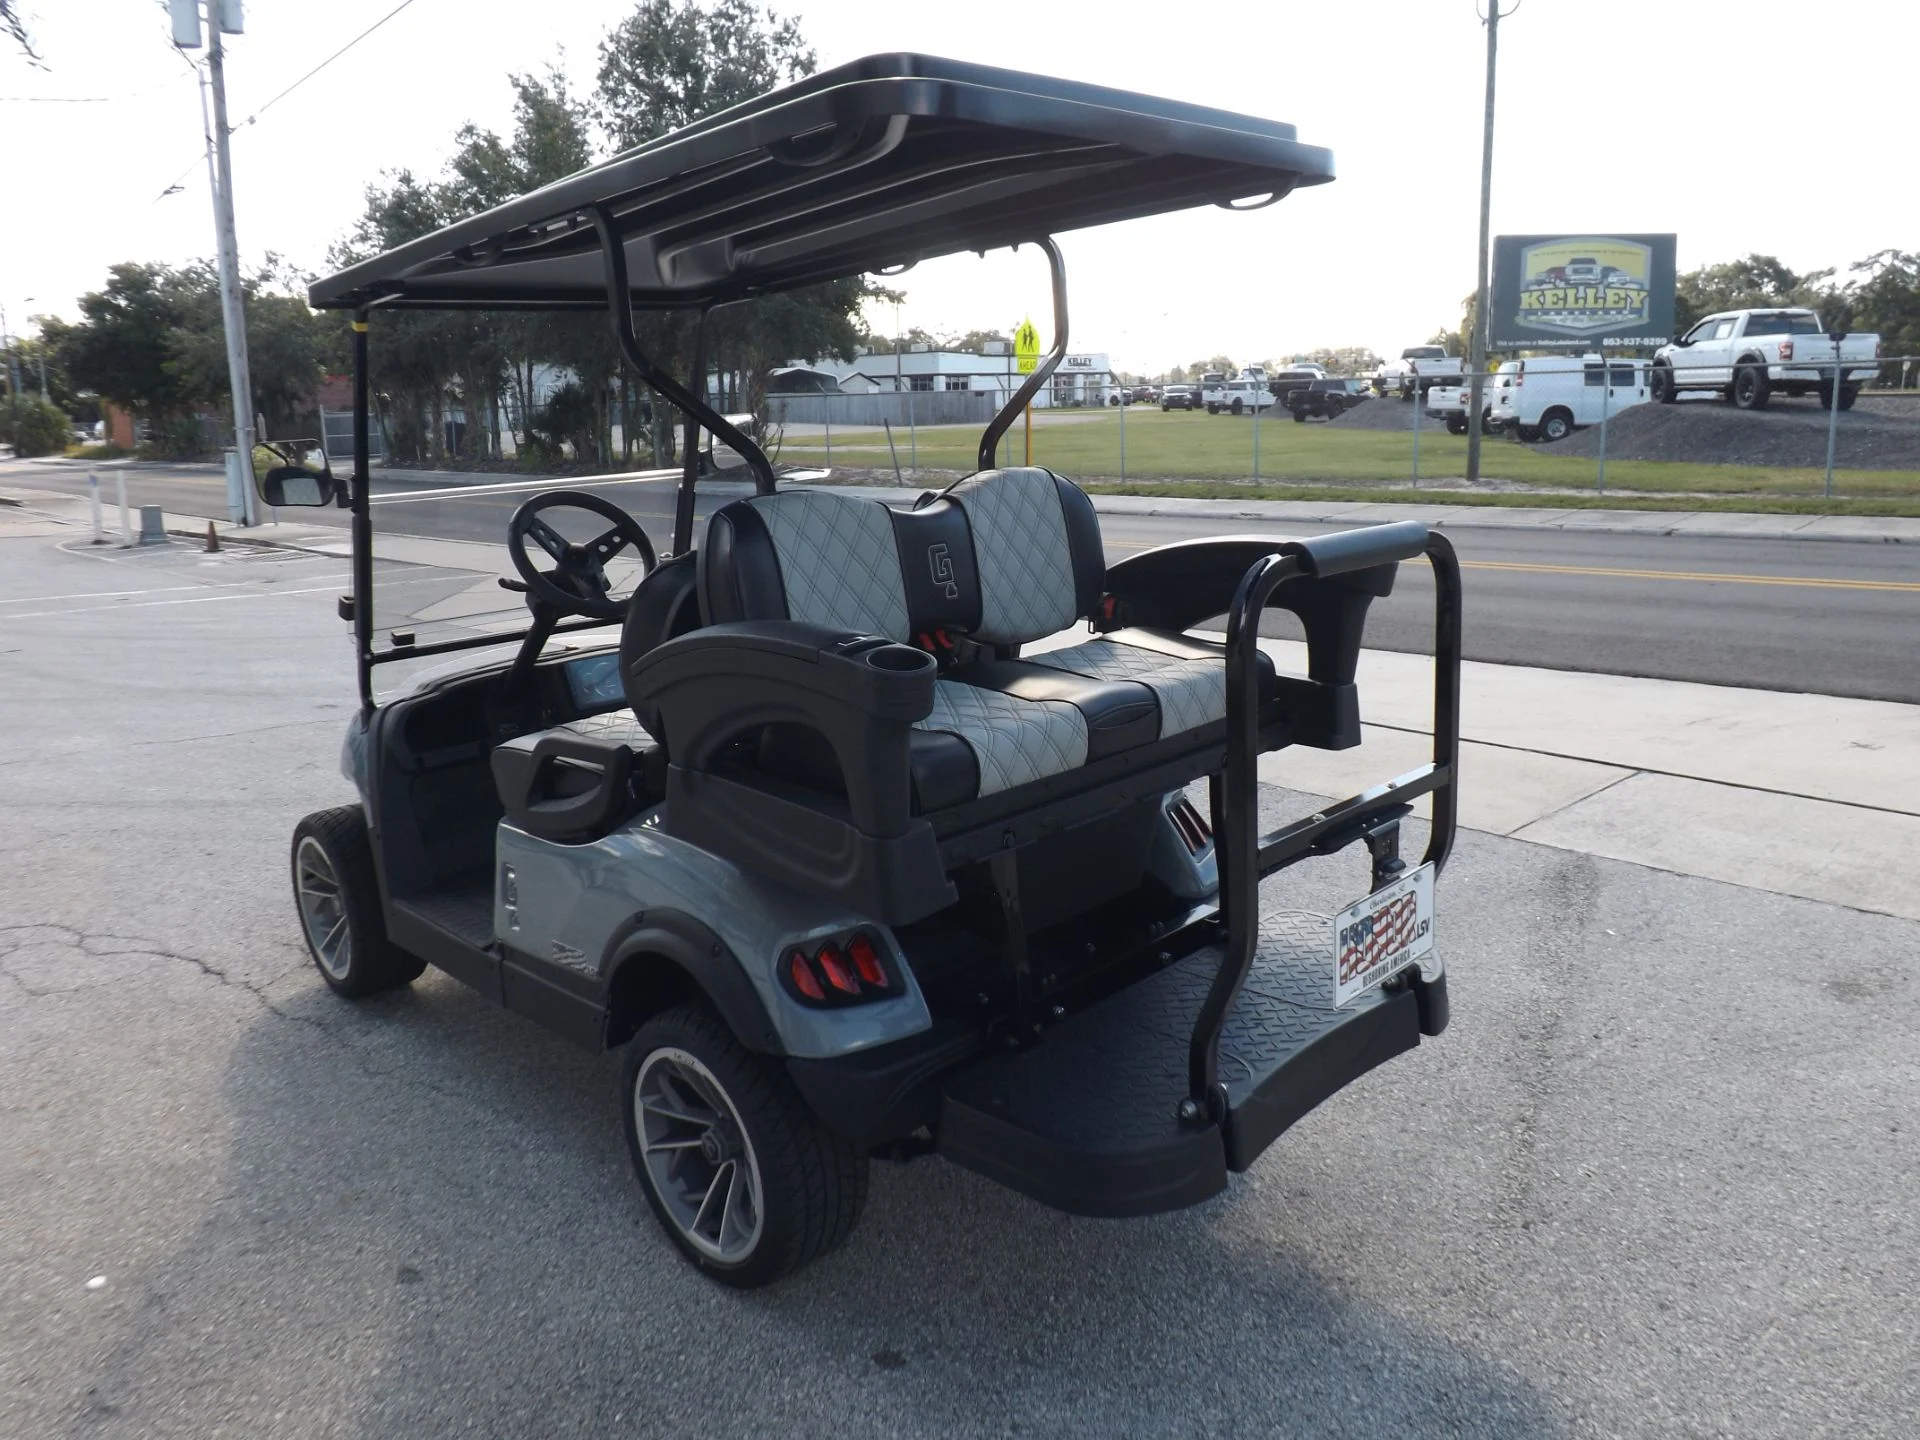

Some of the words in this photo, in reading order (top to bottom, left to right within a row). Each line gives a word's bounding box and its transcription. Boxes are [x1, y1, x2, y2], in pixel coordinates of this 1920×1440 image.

[1519, 287, 1649, 310] KELLEY
[1019, 360, 1036, 370] AHEAD
[1067, 357, 1093, 366] KELLEY
[1417, 917, 1430, 939] LSV
[1390, 948, 1410, 968] AMERICA
